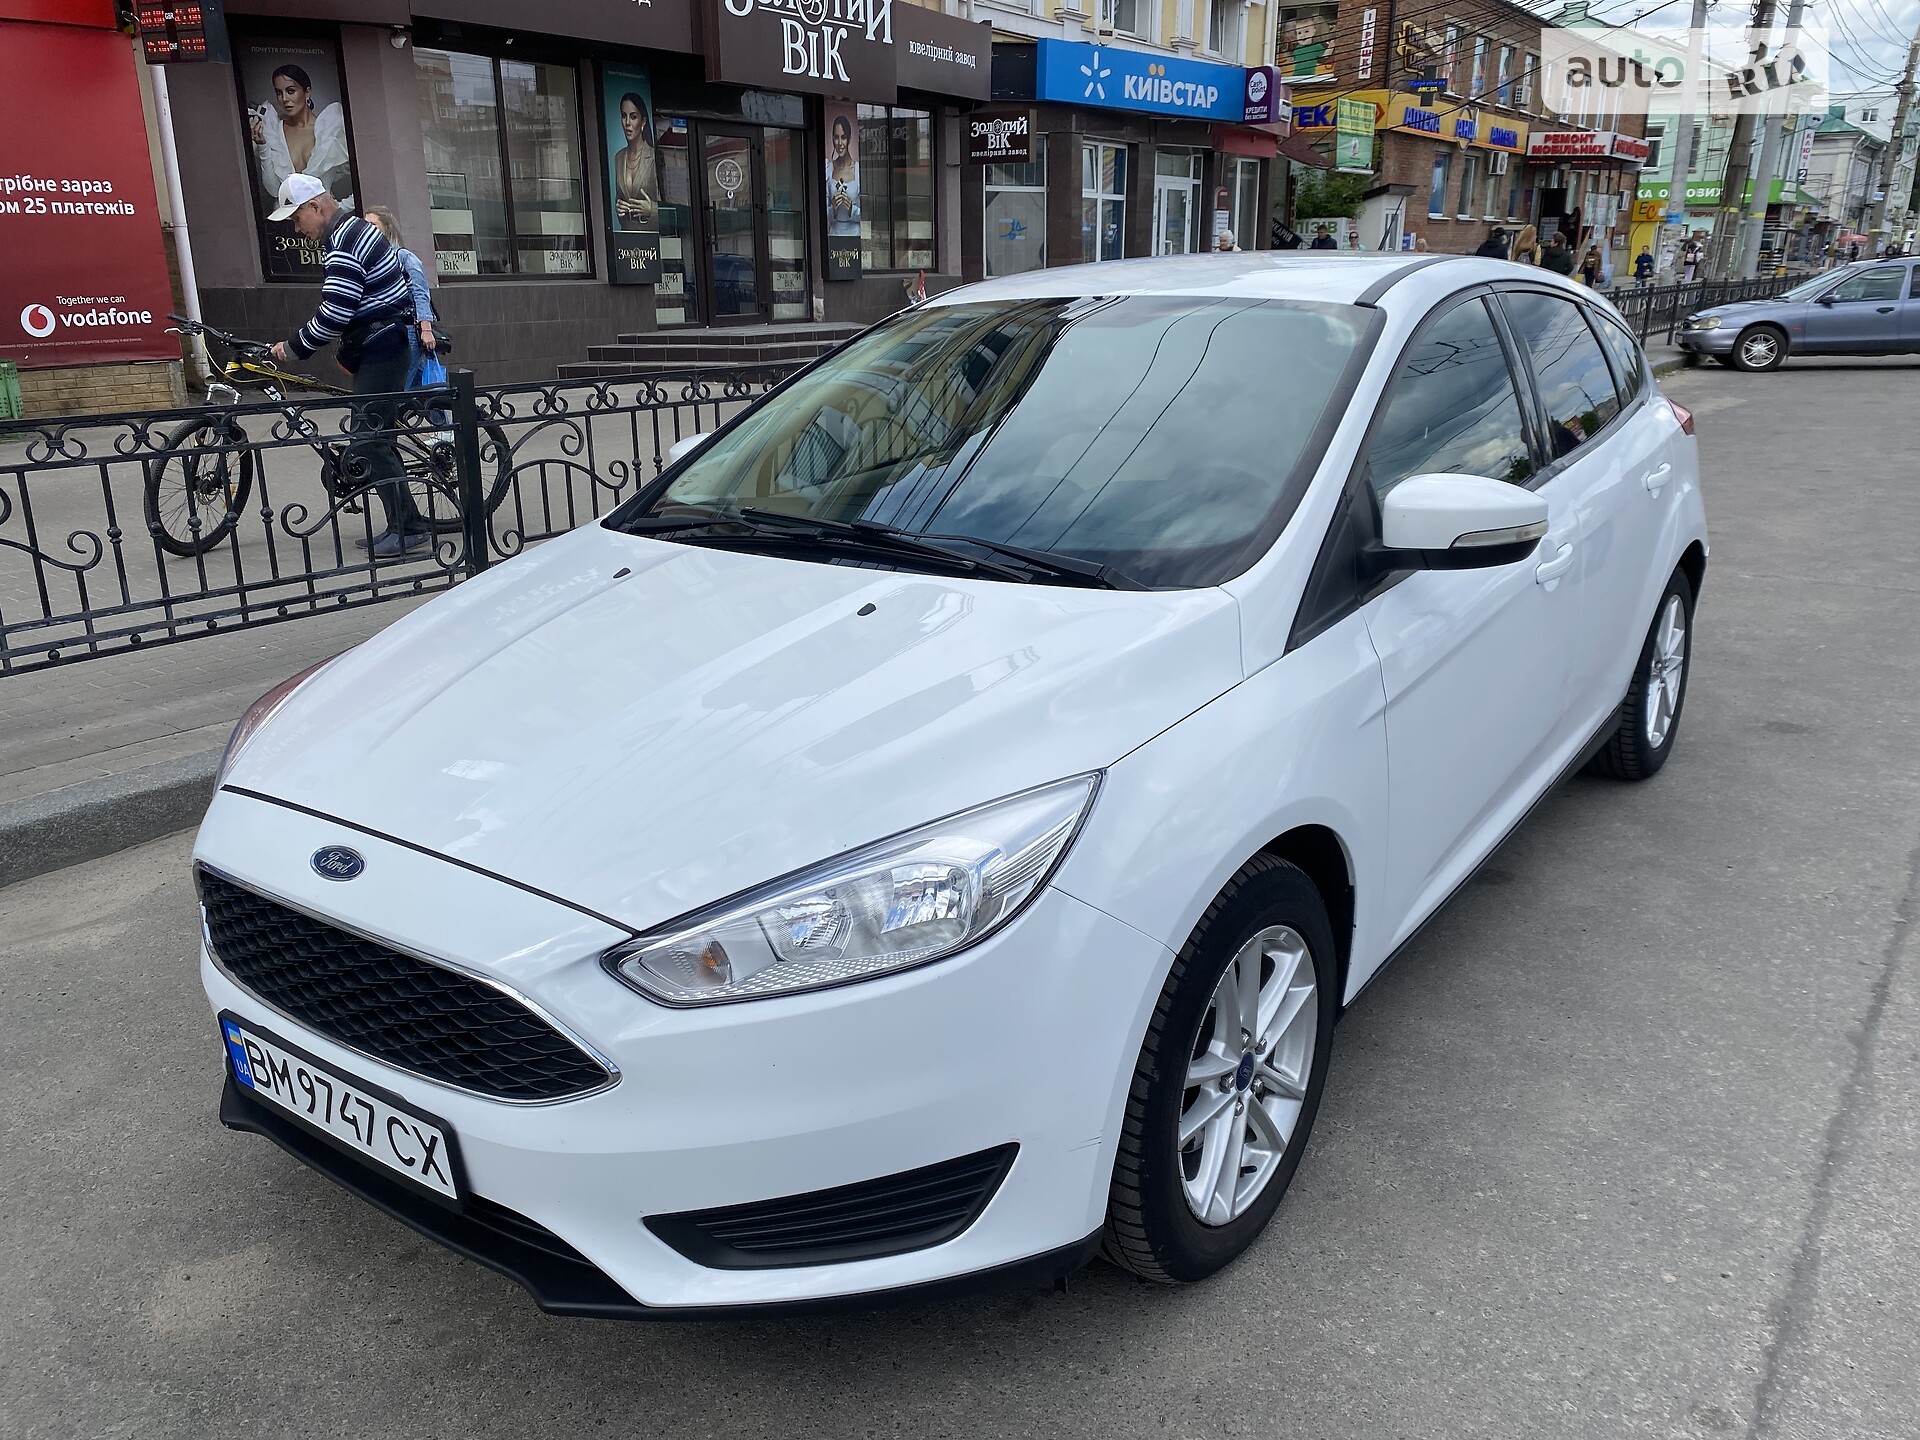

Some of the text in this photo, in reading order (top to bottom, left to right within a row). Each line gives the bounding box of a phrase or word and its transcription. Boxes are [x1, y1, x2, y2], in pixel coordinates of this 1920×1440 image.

[780, 18, 850, 82] ВІК
[909, 40, 976, 69] ювелірний завод
[1125, 63, 1218, 108] КИЇВСТАР
[1403, 106, 1440, 133] АПТЕКА
[987, 132, 1011, 149] ВІК
[1544, 133, 1597, 143] РЕМОНТ
[1531, 144, 1607, 154] МОБІЛЬНИХ
[61, 180, 113, 196] зараз
[23, 198, 47, 214] 25
[51, 200, 135, 215] платежів
[56, 296, 94, 306] Together
[60, 308, 152, 327] vodafone
[320, 851, 354, 873] Ford
[236, 1058, 251, 1077] UA
[244, 1037, 449, 1187] BM 9747 CX
